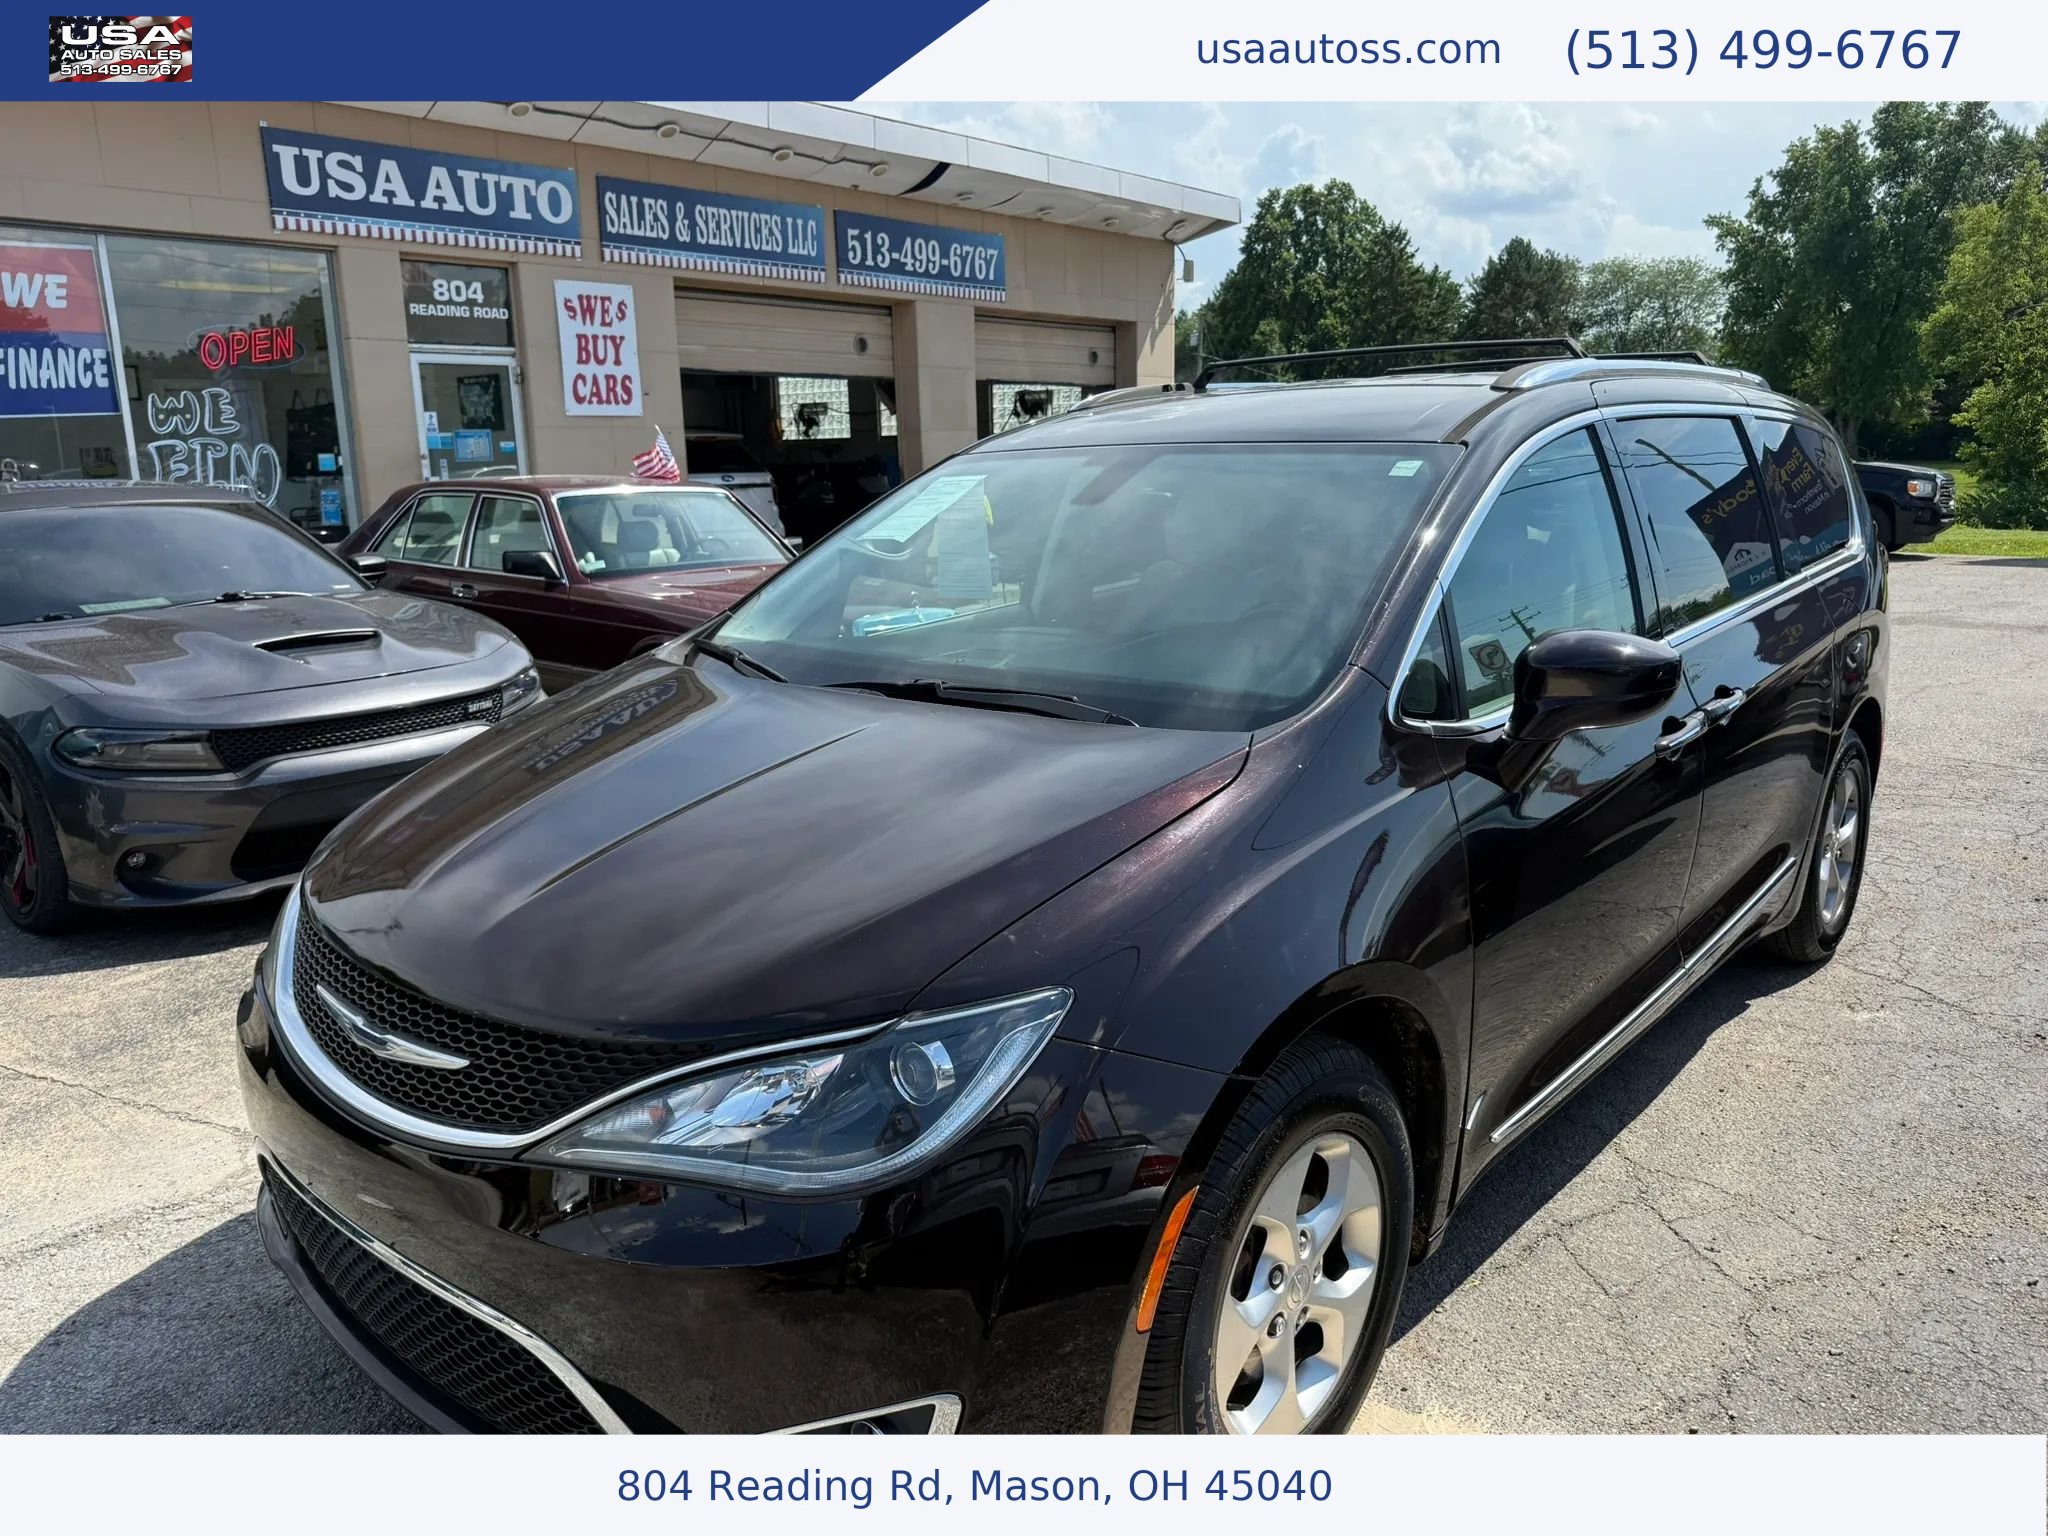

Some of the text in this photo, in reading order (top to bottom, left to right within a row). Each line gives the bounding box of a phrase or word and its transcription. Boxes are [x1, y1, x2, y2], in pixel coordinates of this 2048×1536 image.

[272, 144, 574, 225] USA AUTO
[604, 191, 817, 257] SALES & SERVICES LLC
[846, 228, 999, 281] 513-499-6767
[0, 271, 68, 309] WE
[432, 279, 484, 303] 804
[409, 303, 509, 320] READING ROAD
[200, 326, 294, 371] OPEN
[576, 333, 625, 366] BUY
[572, 373, 633, 406] CARS
[147, 387, 240, 435] WE
